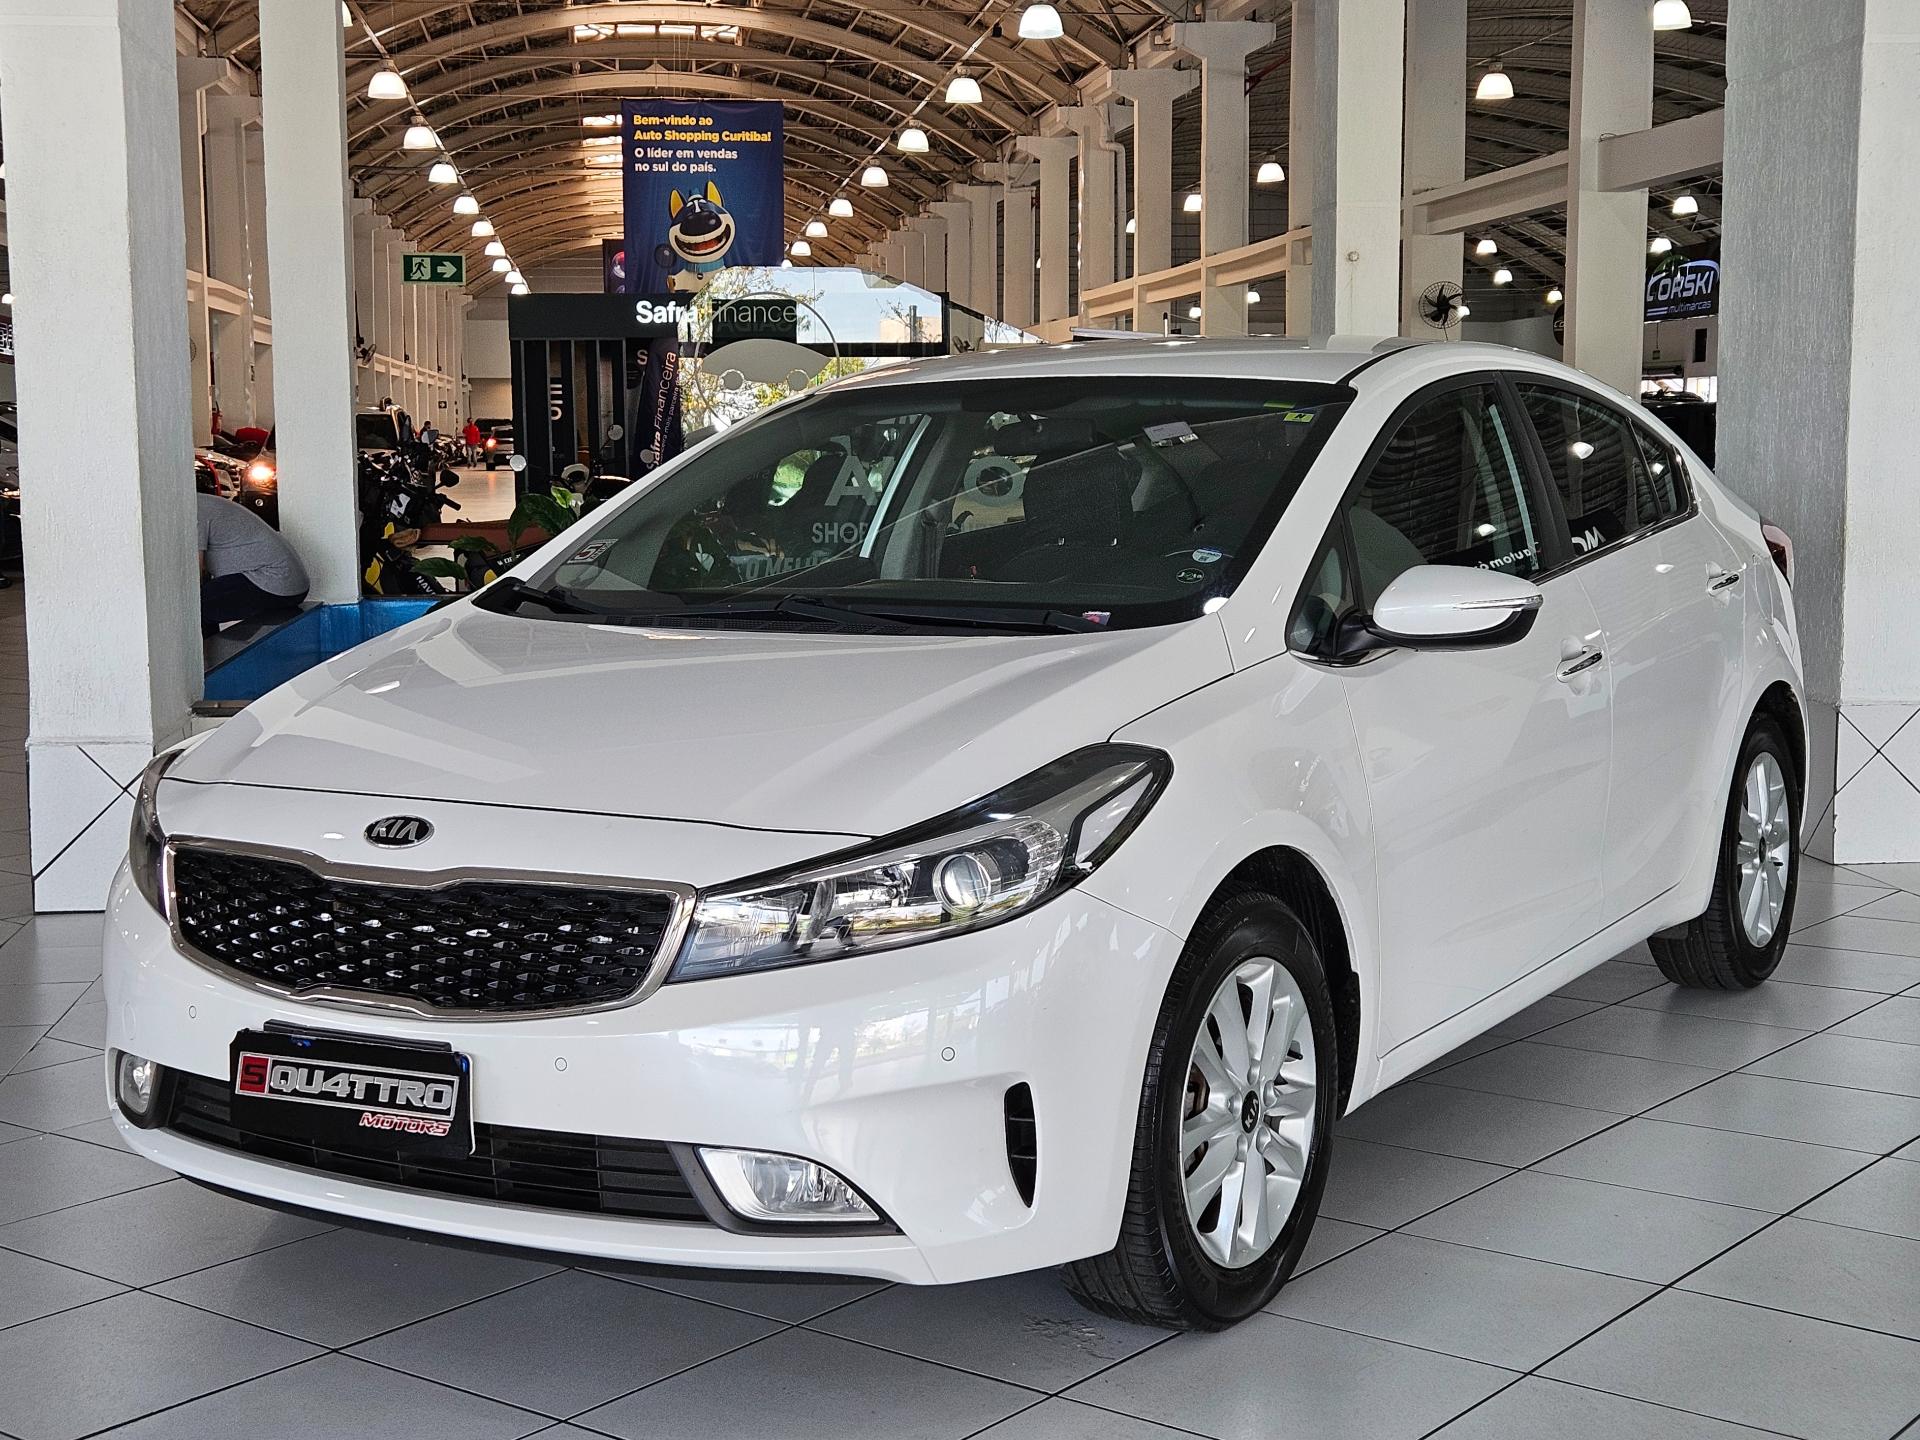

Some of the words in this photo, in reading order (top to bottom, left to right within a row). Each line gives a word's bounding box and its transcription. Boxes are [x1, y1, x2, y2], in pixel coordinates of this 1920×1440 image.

[633, 115, 697, 126] Bem-vindo
[698, 117, 713, 126] ao
[634, 130, 662, 140] Auto
[664, 130, 720, 143] Shopping
[721, 131, 772, 142] Curitiba!
[634, 147, 645, 158] O
[646, 147, 674, 159] líder
[675, 150, 695, 159] em
[696, 148, 738, 160] vendas
[634, 163, 650, 172] no
[652, 161, 669, 172] sul
[671, 161, 688, 172] do
[689, 161, 717, 174] país.
[635, 300, 698, 324] Safra
[653, 351, 677, 430] Financeira
[371, 819, 419, 841] KIA
[359, 1112, 450, 1137] MOTORS
[1245, 1098, 1259, 1129] KIA
